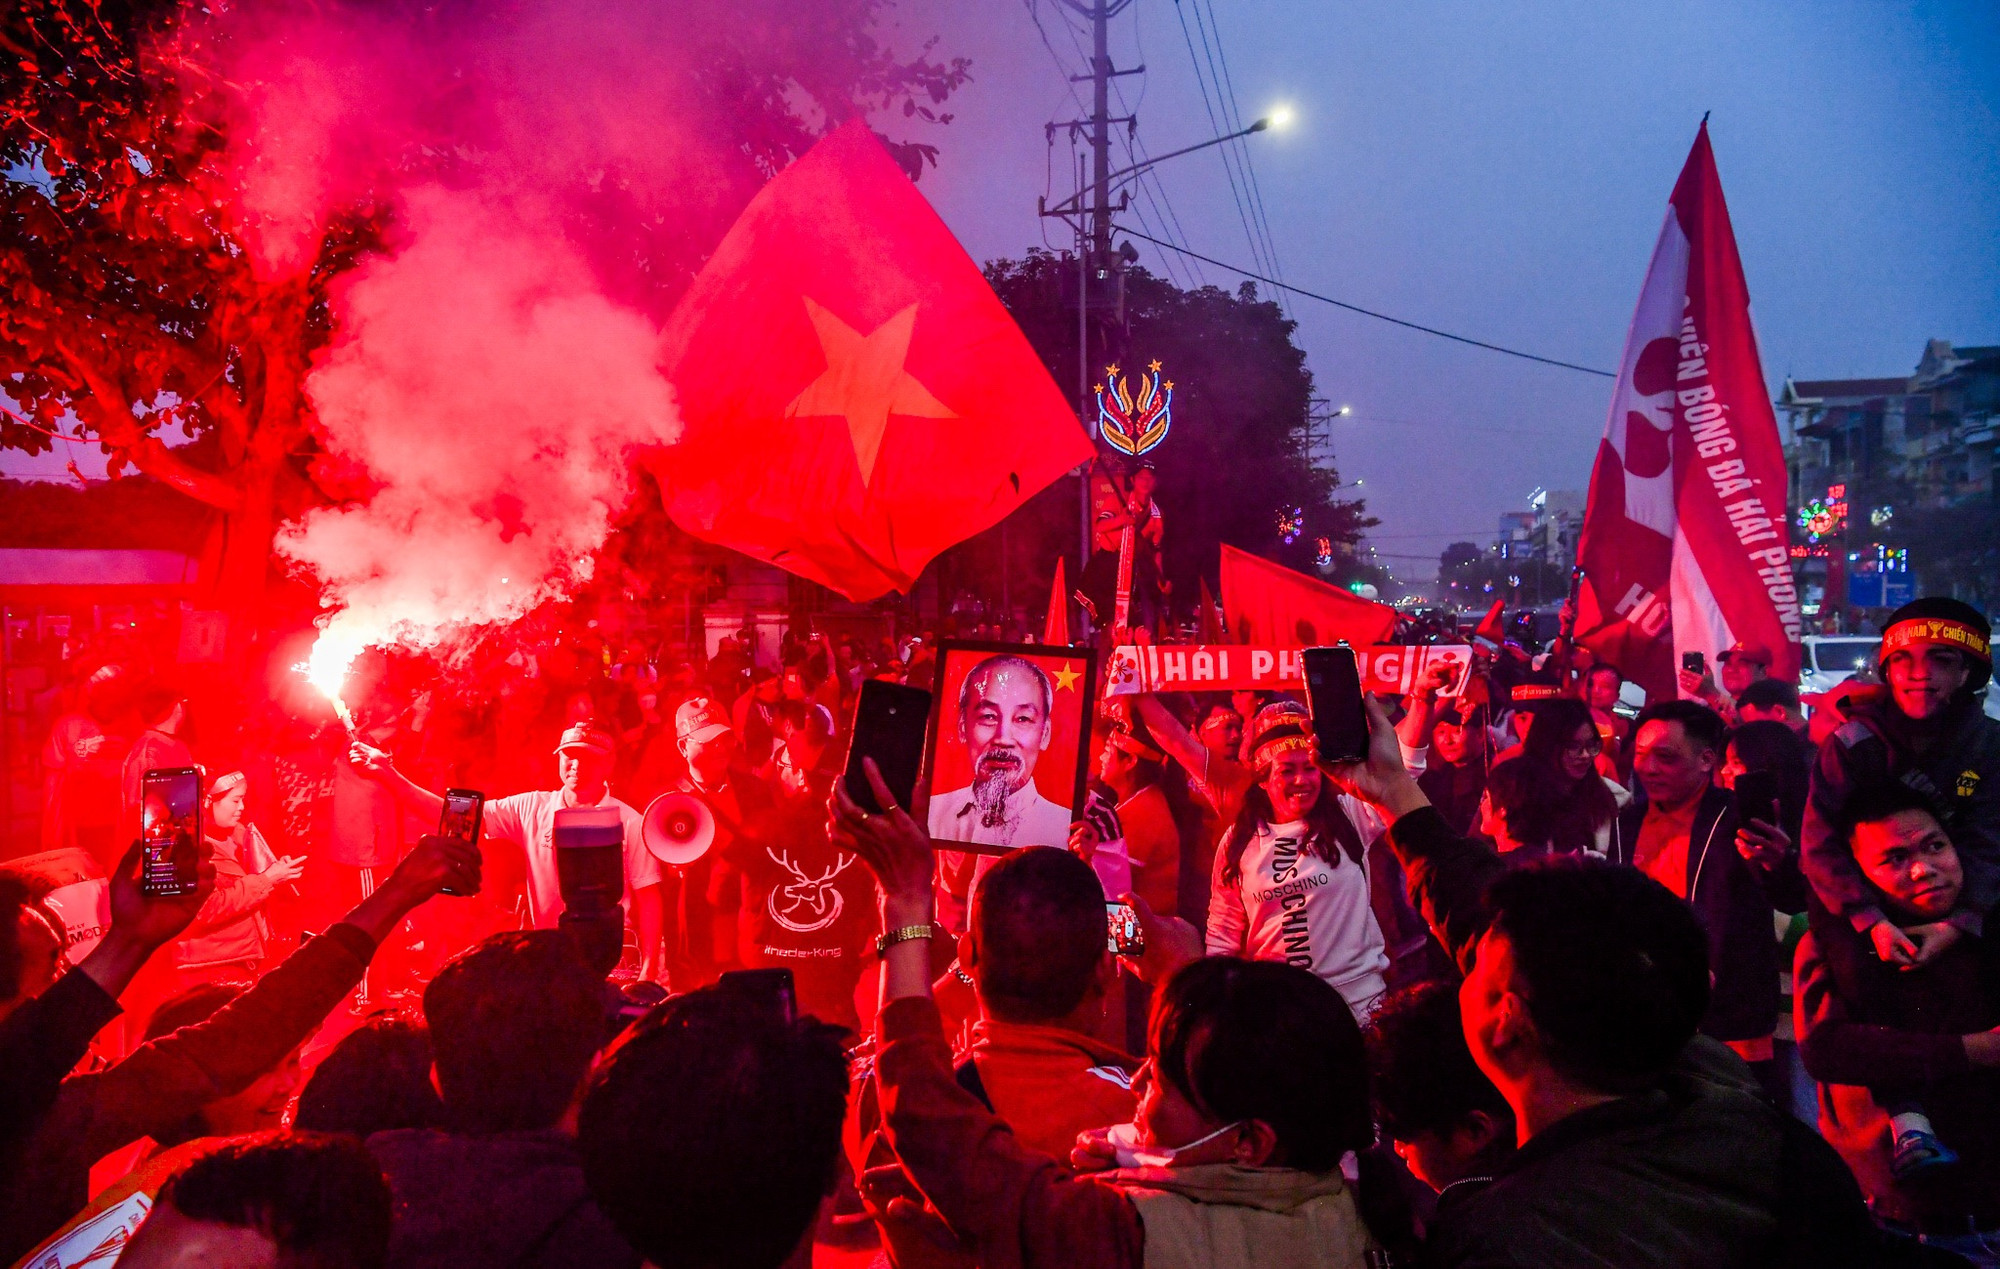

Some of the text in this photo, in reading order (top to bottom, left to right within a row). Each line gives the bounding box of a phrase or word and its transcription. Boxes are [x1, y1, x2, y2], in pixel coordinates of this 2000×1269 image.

[1677, 384, 1737, 459] BÓNG
[1707, 458, 1762, 499] ĐÁ
[1251, 650, 1400, 682] PHG
[1252, 873, 1328, 903] MOSCHINO
